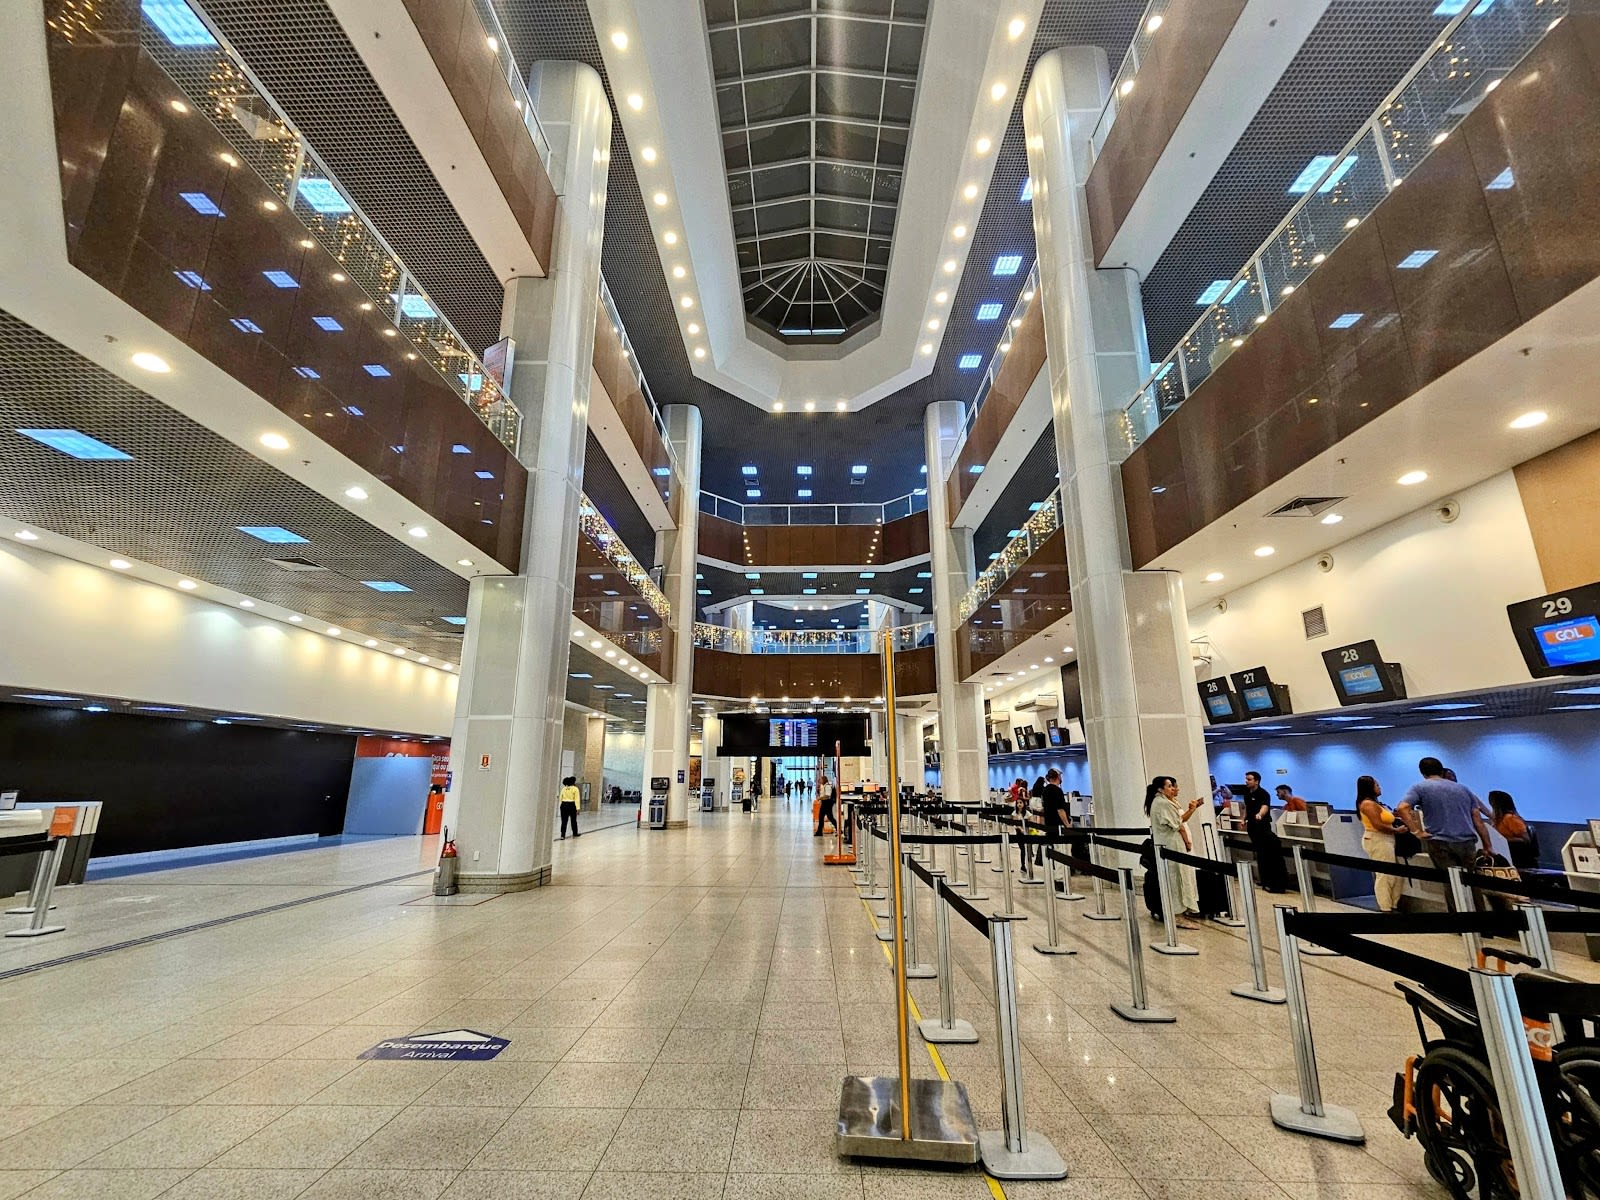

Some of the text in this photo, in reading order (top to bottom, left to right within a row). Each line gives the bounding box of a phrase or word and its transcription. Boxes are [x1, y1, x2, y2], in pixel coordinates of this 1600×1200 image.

[1541, 597, 1573, 619] 29
[1555, 627, 1584, 642] GOL
[1340, 648, 1359, 663] 28
[1243, 672, 1255, 684] 27
[1206, 682, 1218, 693] 26
[377, 1041, 502, 1052] Desembarque
[401, 1051, 457, 1059] Arrival
